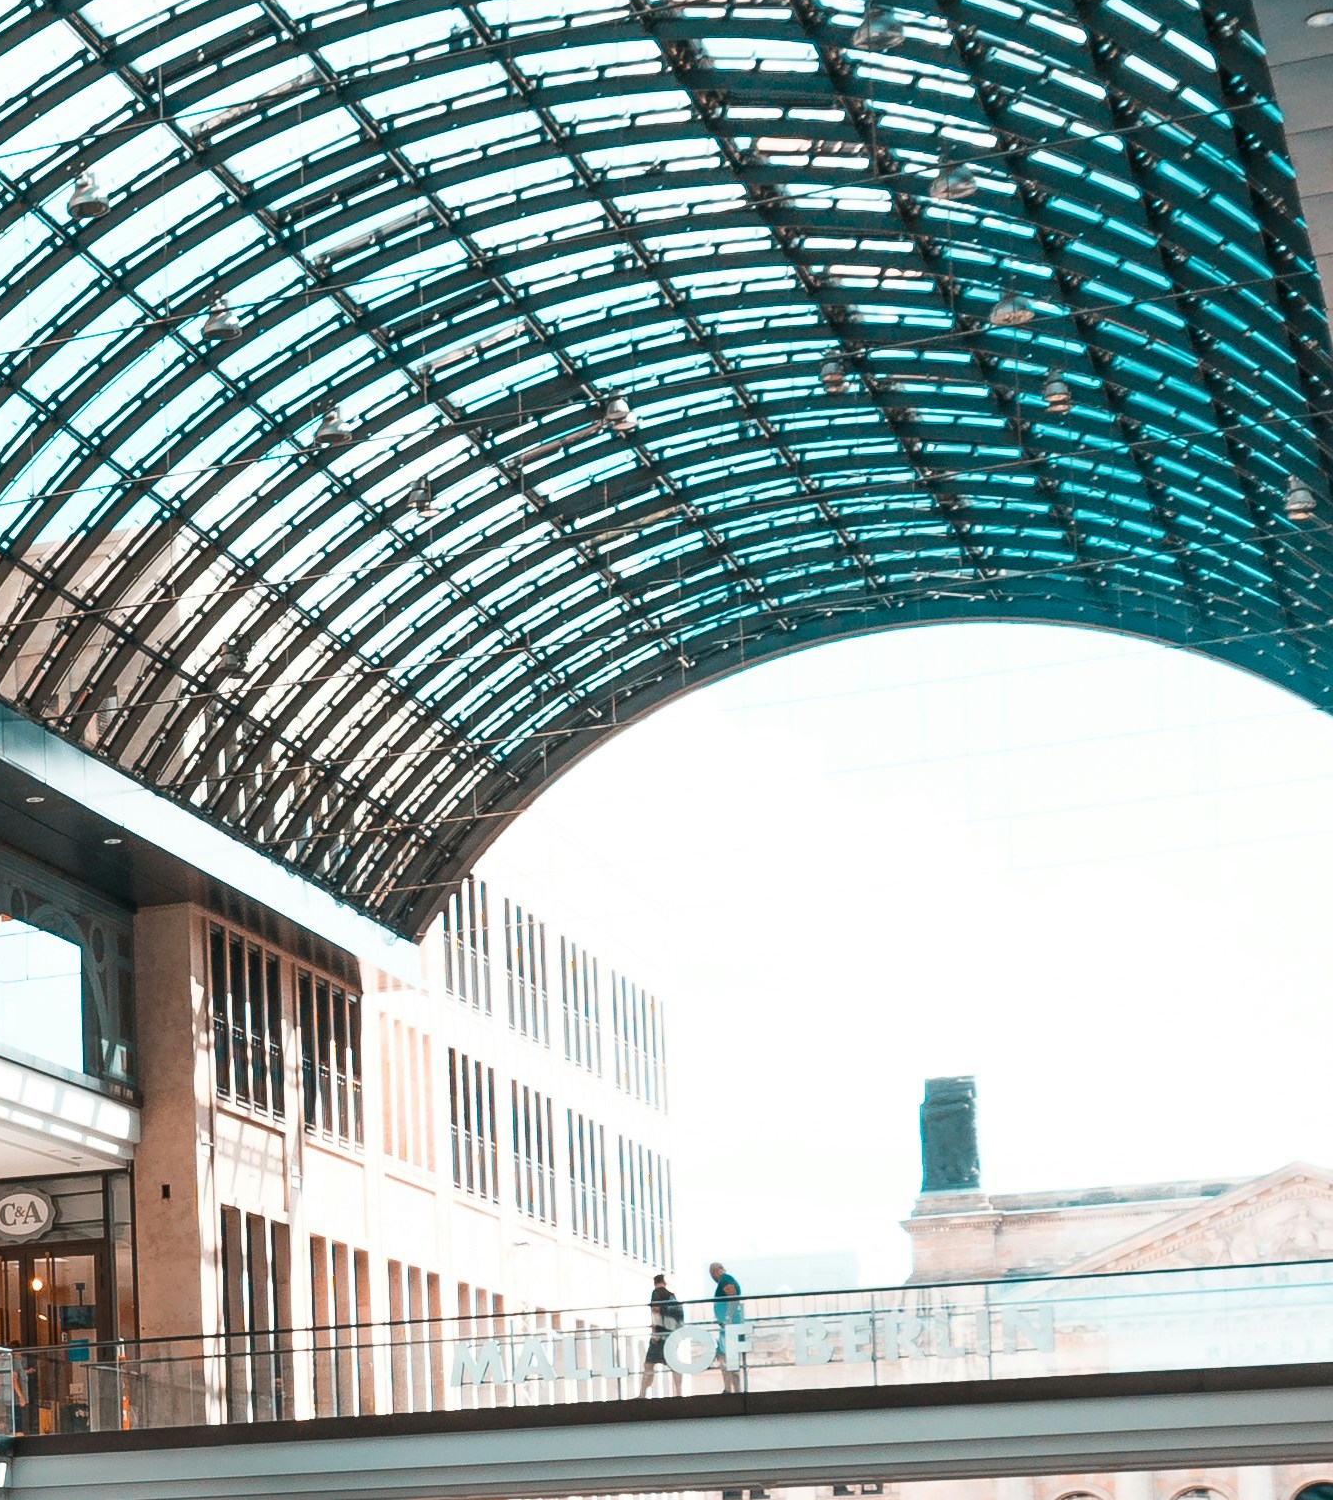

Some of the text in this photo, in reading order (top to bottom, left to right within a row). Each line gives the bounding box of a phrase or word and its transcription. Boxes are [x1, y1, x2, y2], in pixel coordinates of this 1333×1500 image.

[0, 1200, 44, 1226] C&A
[451, 1305, 1055, 1386] MALL OF BERLIN
